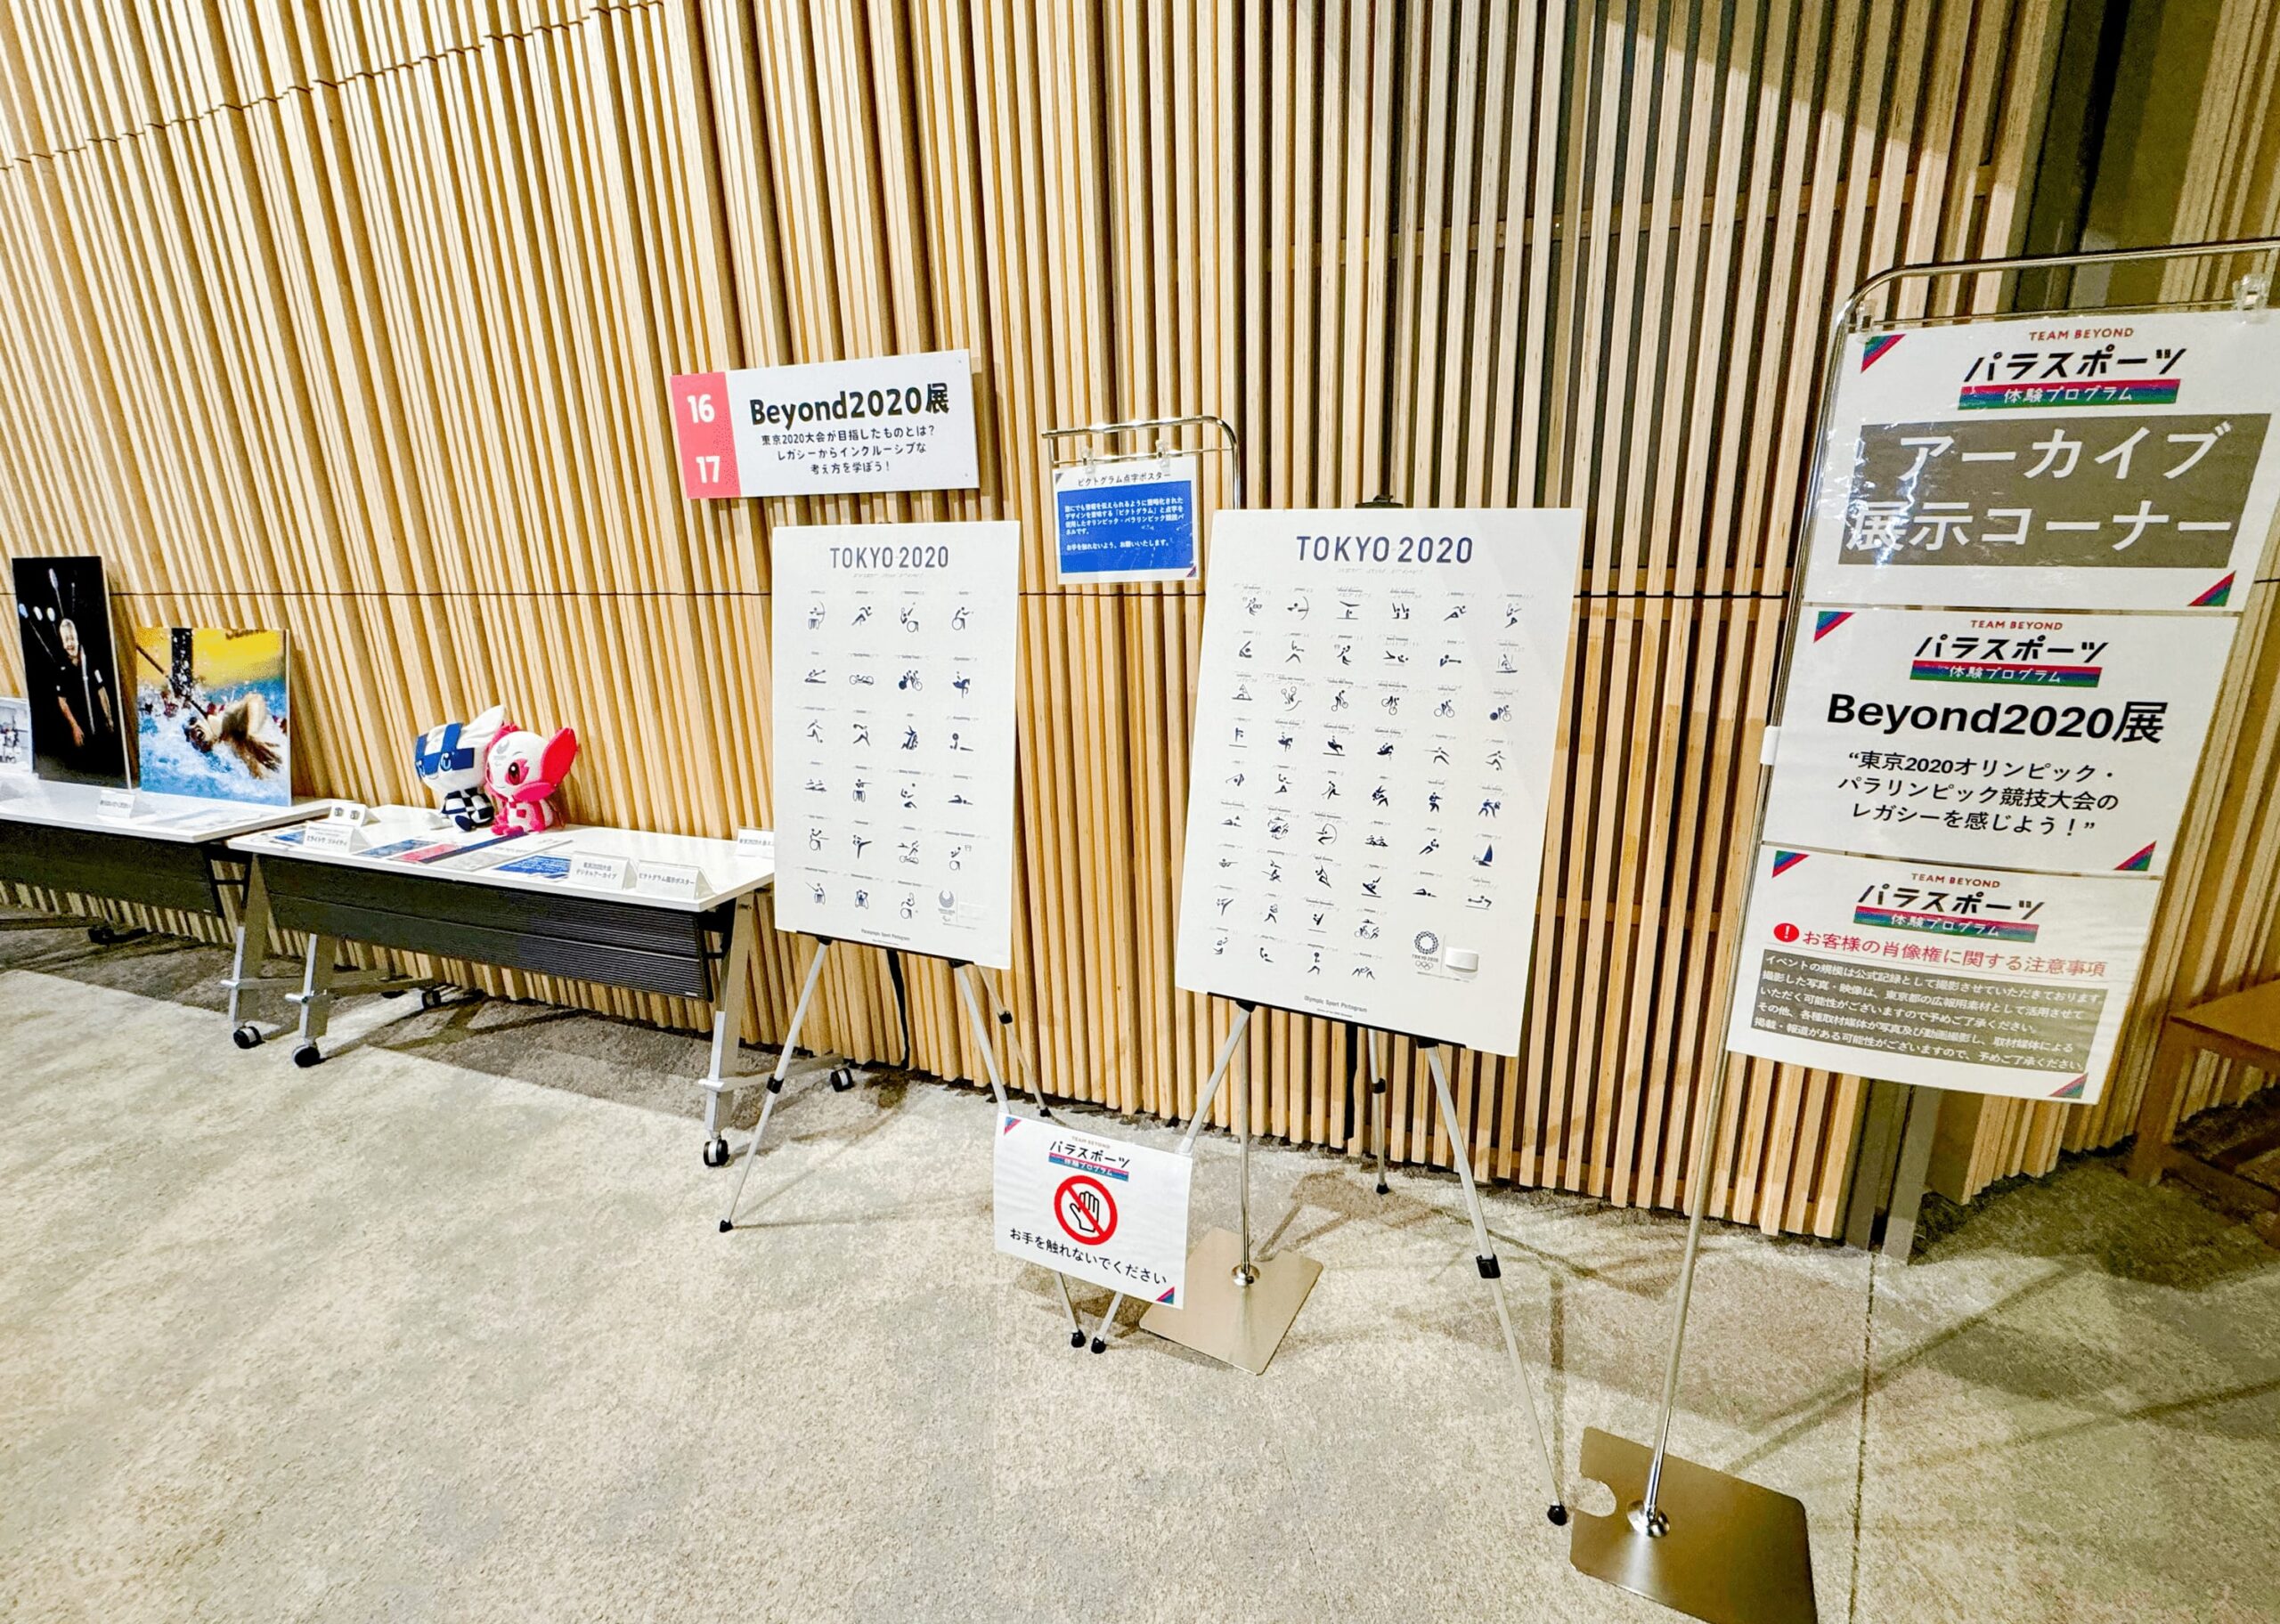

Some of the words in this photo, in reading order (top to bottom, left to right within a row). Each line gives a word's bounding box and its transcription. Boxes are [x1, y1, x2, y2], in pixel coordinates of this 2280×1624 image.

[2029, 328, 2069, 342] TEAM
[2073, 326, 2135, 340] BEYOND
[1963, 344, 2186, 383] パラスポーツ
[687, 393, 715, 424] 16
[749, 382, 950, 431] Beyond2020展
[2003, 386, 2134, 405] 体験プログラム
[777, 442, 927, 461] レガシーからインクルーシブな
[1898, 420, 2232, 481] アーカイブ
[695, 455, 721, 484] 17
[1078, 472, 1172, 487] ピクトグラム点字ポスター
[1845, 499, 2232, 552] 展示コーナー
[829, 547, 893, 568] TOKYO
[898, 545, 949, 568] 2020
[1295, 535, 1389, 563] TOKYO
[1396, 536, 1473, 564] 2020
[1970, 620, 2006, 630] TEAM
[2008, 621, 2064, 631] BEYOND
[1913, 634, 2108, 664] パラスポーツ
[1948, 666, 2062, 684] 体験プログラム
[1826, 692, 2169, 744] Beyond2020展
[1837, 776, 2119, 811] パラリンピック競技大会の
[1911, 873, 1945, 884] TEAM
[1949, 876, 2001, 889] BEYOND
[1857, 883, 2046, 921] パラスポーツ
[1890, 914, 2000, 937] 体験プログラム
[1803, 930, 2109, 978] お客様の肖像権に関する注意事項
[1049, 1140, 1130, 1169] パラスポーツ
[1009, 1227, 1167, 1285] お手を触れないでください
